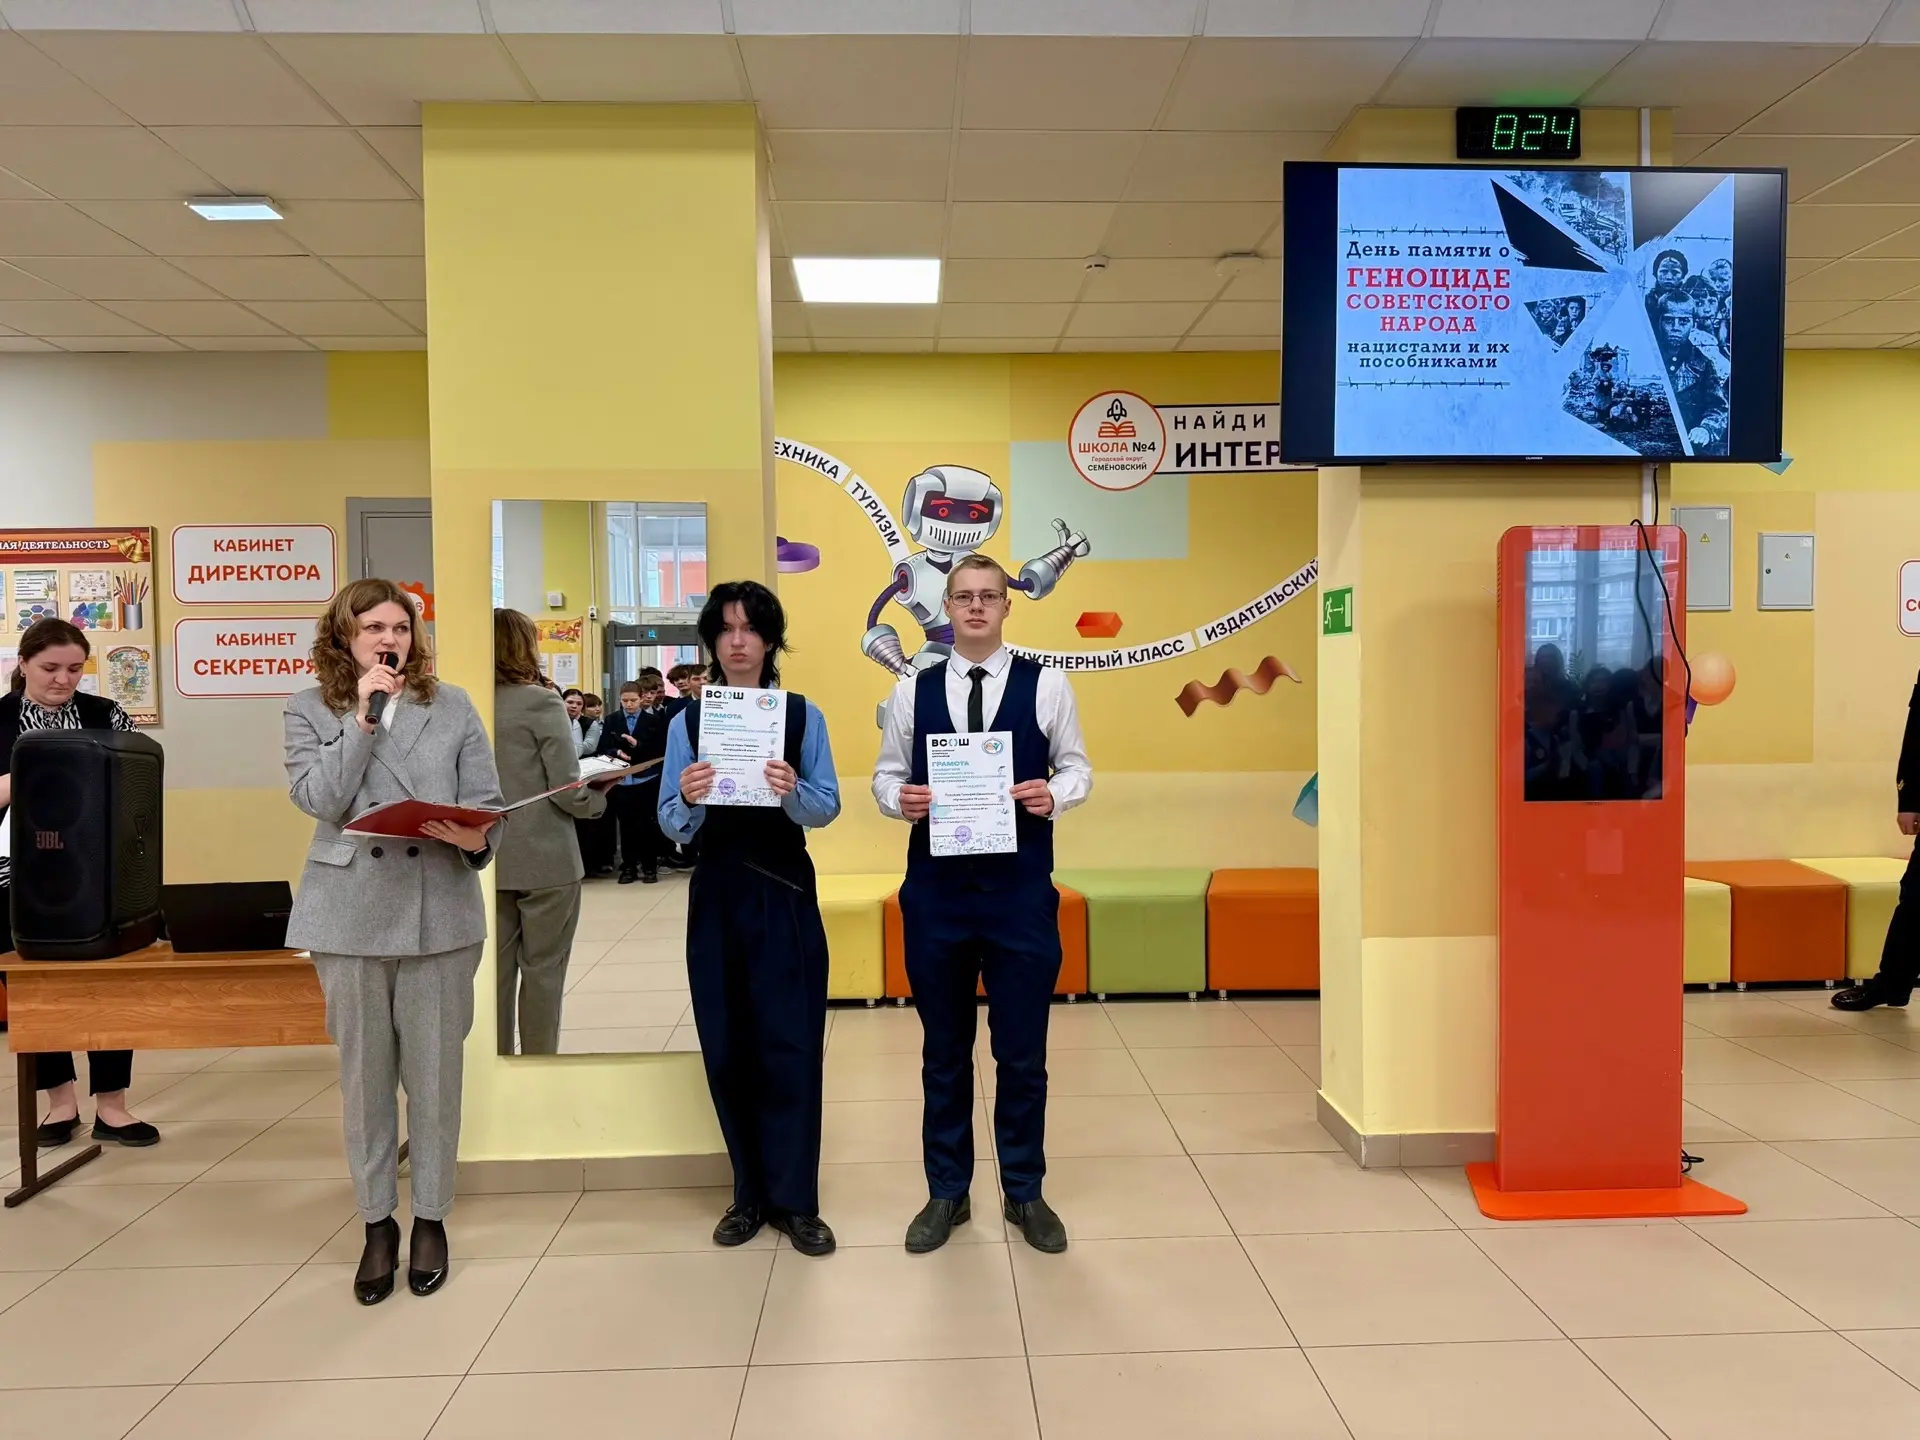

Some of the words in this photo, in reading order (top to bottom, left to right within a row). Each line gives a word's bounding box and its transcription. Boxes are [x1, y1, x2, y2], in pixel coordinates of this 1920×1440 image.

[1346, 241, 1400, 259] День
[1408, 245, 1491, 258] памяти
[1498, 246, 1510, 258] о
[1346, 268, 1511, 292] ГЕНОЦИДЕ
[1346, 293, 1511, 311] СОВЕТСКОГО
[1379, 316, 1477, 334] НАРОДА
[1347, 342, 1460, 355] нацистами
[1468, 343, 1480, 353] и
[1487, 343, 1510, 354] их
[1359, 354, 1498, 368] пособниками
[1174, 410, 1266, 432] НАЙДИ
[1078, 441, 1129, 454] ШКОЛА
[1132, 441, 1156, 453] №4
[1087, 462, 1147, 472] СЕМЁНОВСКИЙ
[851, 481, 900, 547] ТУРИЗМ
[20, 540, 110, 551] ДЕЯТЕЛЬНОСТЬ
[213, 538, 295, 552] КАБИНЕТ
[187, 564, 321, 585] ДИРЕКТОРА
[216, 632, 297, 646] КАБИНЕТ
[1128, 639, 1185, 664] КЛАСС
[193, 658, 319, 676] СЕКРЕТАРЯ
[704, 712, 743, 720] ГРАМОТА
[35, 831, 64, 849] JBL
